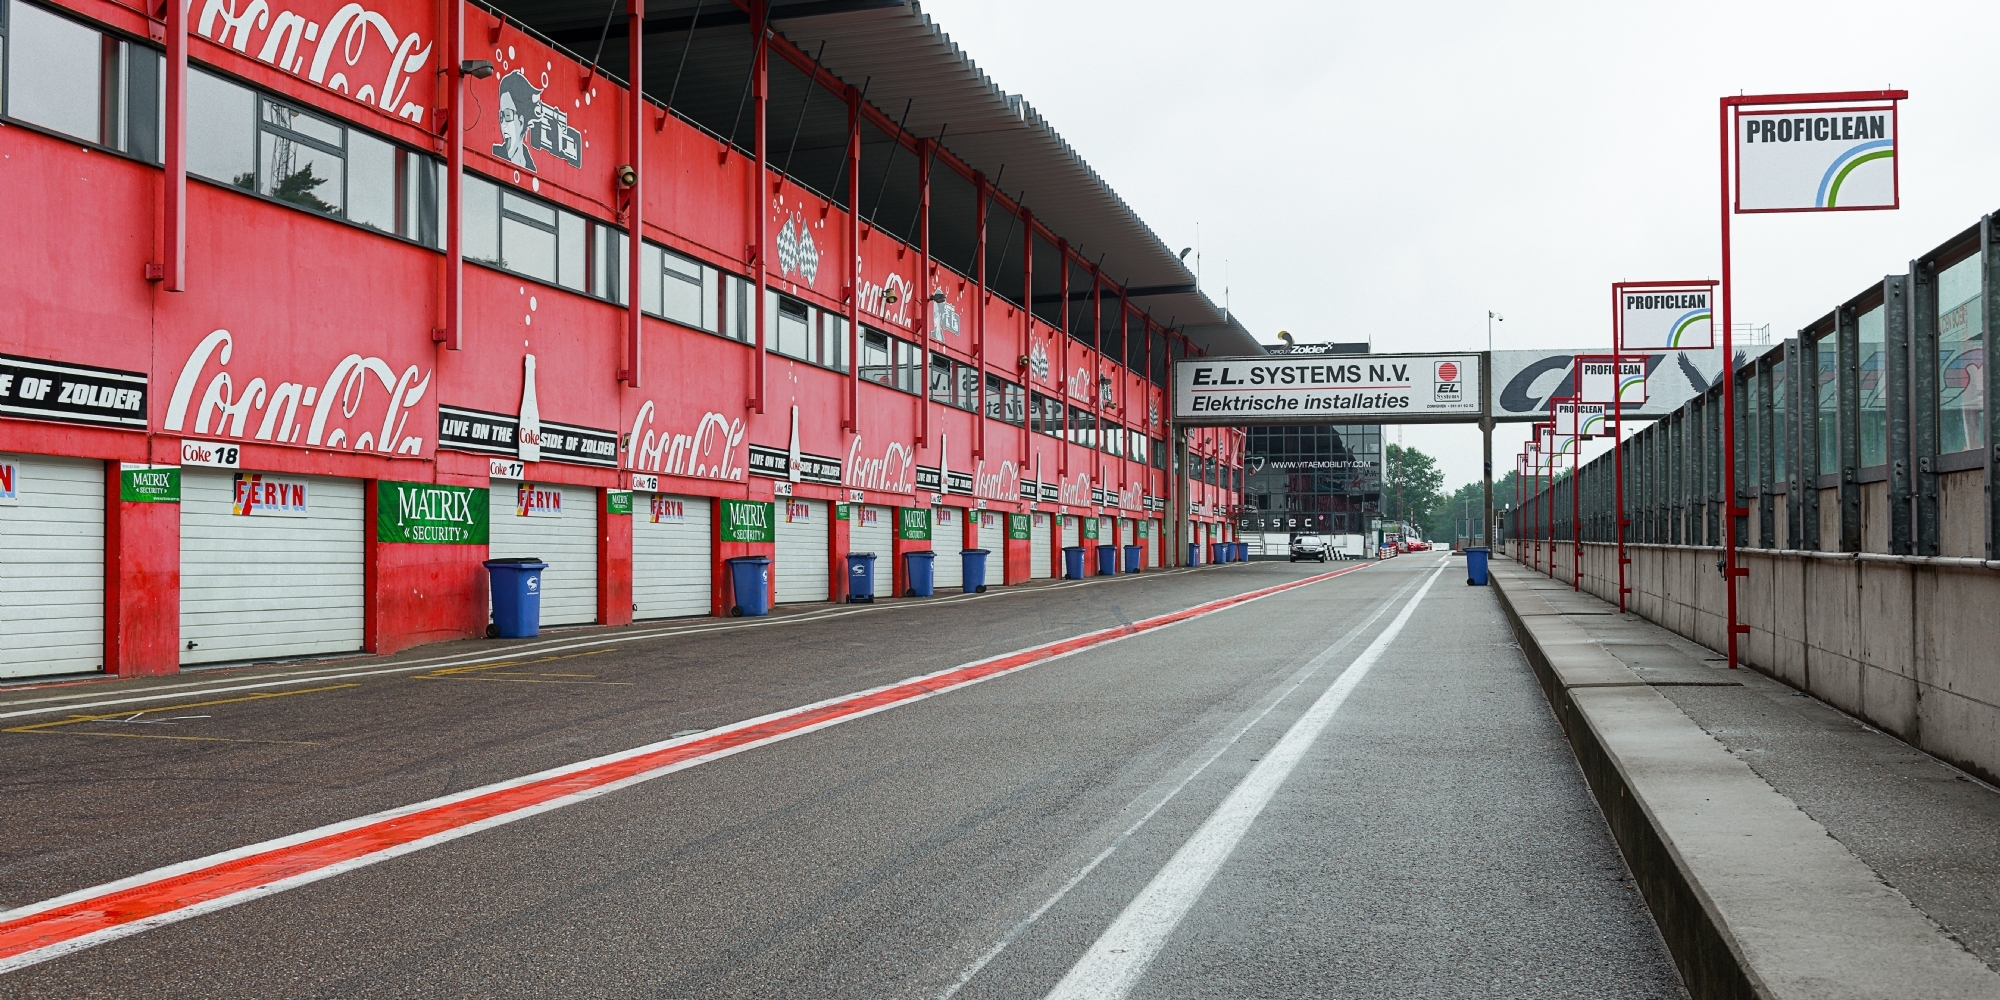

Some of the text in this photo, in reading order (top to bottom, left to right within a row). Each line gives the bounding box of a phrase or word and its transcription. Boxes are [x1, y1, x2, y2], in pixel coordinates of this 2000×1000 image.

[188, 0, 432, 123] oca-Cl
[1747, 116, 1884, 143] PROFICLEAN
[848, 255, 914, 328] oca-Cl
[1627, 294, 1705, 309] PROFICLEAN
[1290, 345, 1328, 354] Zolder
[1193, 364, 1410, 385] E.L. SYSTEMS N.V.
[1585, 365, 1641, 375] PROFILEAN
[19, 377, 52, 401] OF
[57, 382, 143, 411] ZOLDER
[1437, 384, 1459, 393] EL
[1192, 393, 1410, 411] Elektrische installaties
[1559, 405, 1602, 414] PROICLEAN
[442, 419, 615, 457] LIVE ON THE Coke SIDE OF ZOLDER
[182, 444, 238, 464] Coke 18
[490, 461, 523, 477] Coke 17
[750, 453, 764, 464] LIVE
[765, 456, 774, 467] ON
[774, 457, 786, 469] THE
[800, 462, 812, 473] SIDE
[813, 463, 820, 474] OF
[821, 464, 840, 477] ZOLDER
[1271, 460, 1370, 469] WWW.VITAEMOBILITY.COM
[133, 473, 170, 488] MATRIX
[633, 477, 657, 489] Coke 16
[783, 484, 792, 494] 15
[236, 479, 305, 510] FERYN
[519, 488, 562, 512] FERYN
[398, 487, 475, 526] MATRIX
[652, 499, 683, 518] FERYN
[786, 503, 809, 519] FERYN
[730, 502, 768, 530] MATRIX
[905, 508, 927, 531] MATRIX
[1241, 518, 1312, 528] essec
[413, 526, 461, 541] SECURITY
[737, 530, 761, 541] SECURITY
